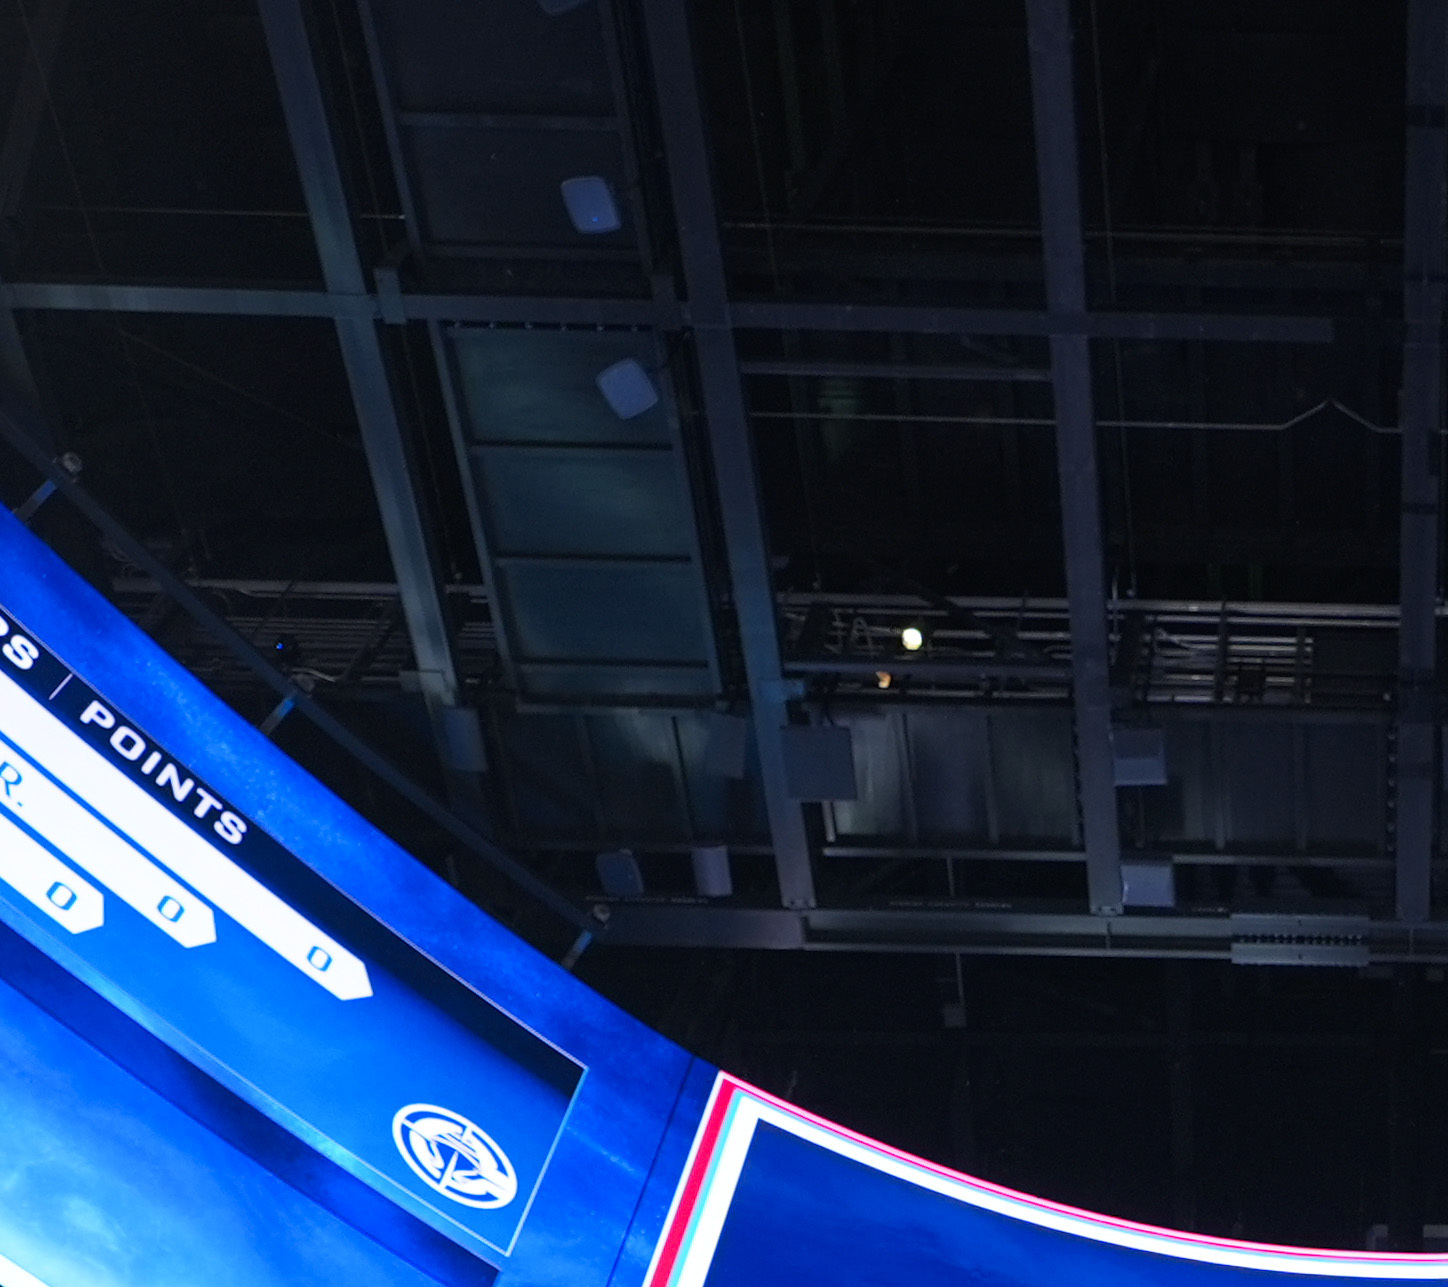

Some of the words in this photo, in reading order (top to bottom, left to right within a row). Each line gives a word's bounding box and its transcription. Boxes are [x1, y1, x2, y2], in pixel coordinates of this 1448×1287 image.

[79, 700, 247, 845] POINTS
[46, 881, 78, 911] 0
[157, 895, 185, 923] 0
[307, 945, 333, 973] 0
